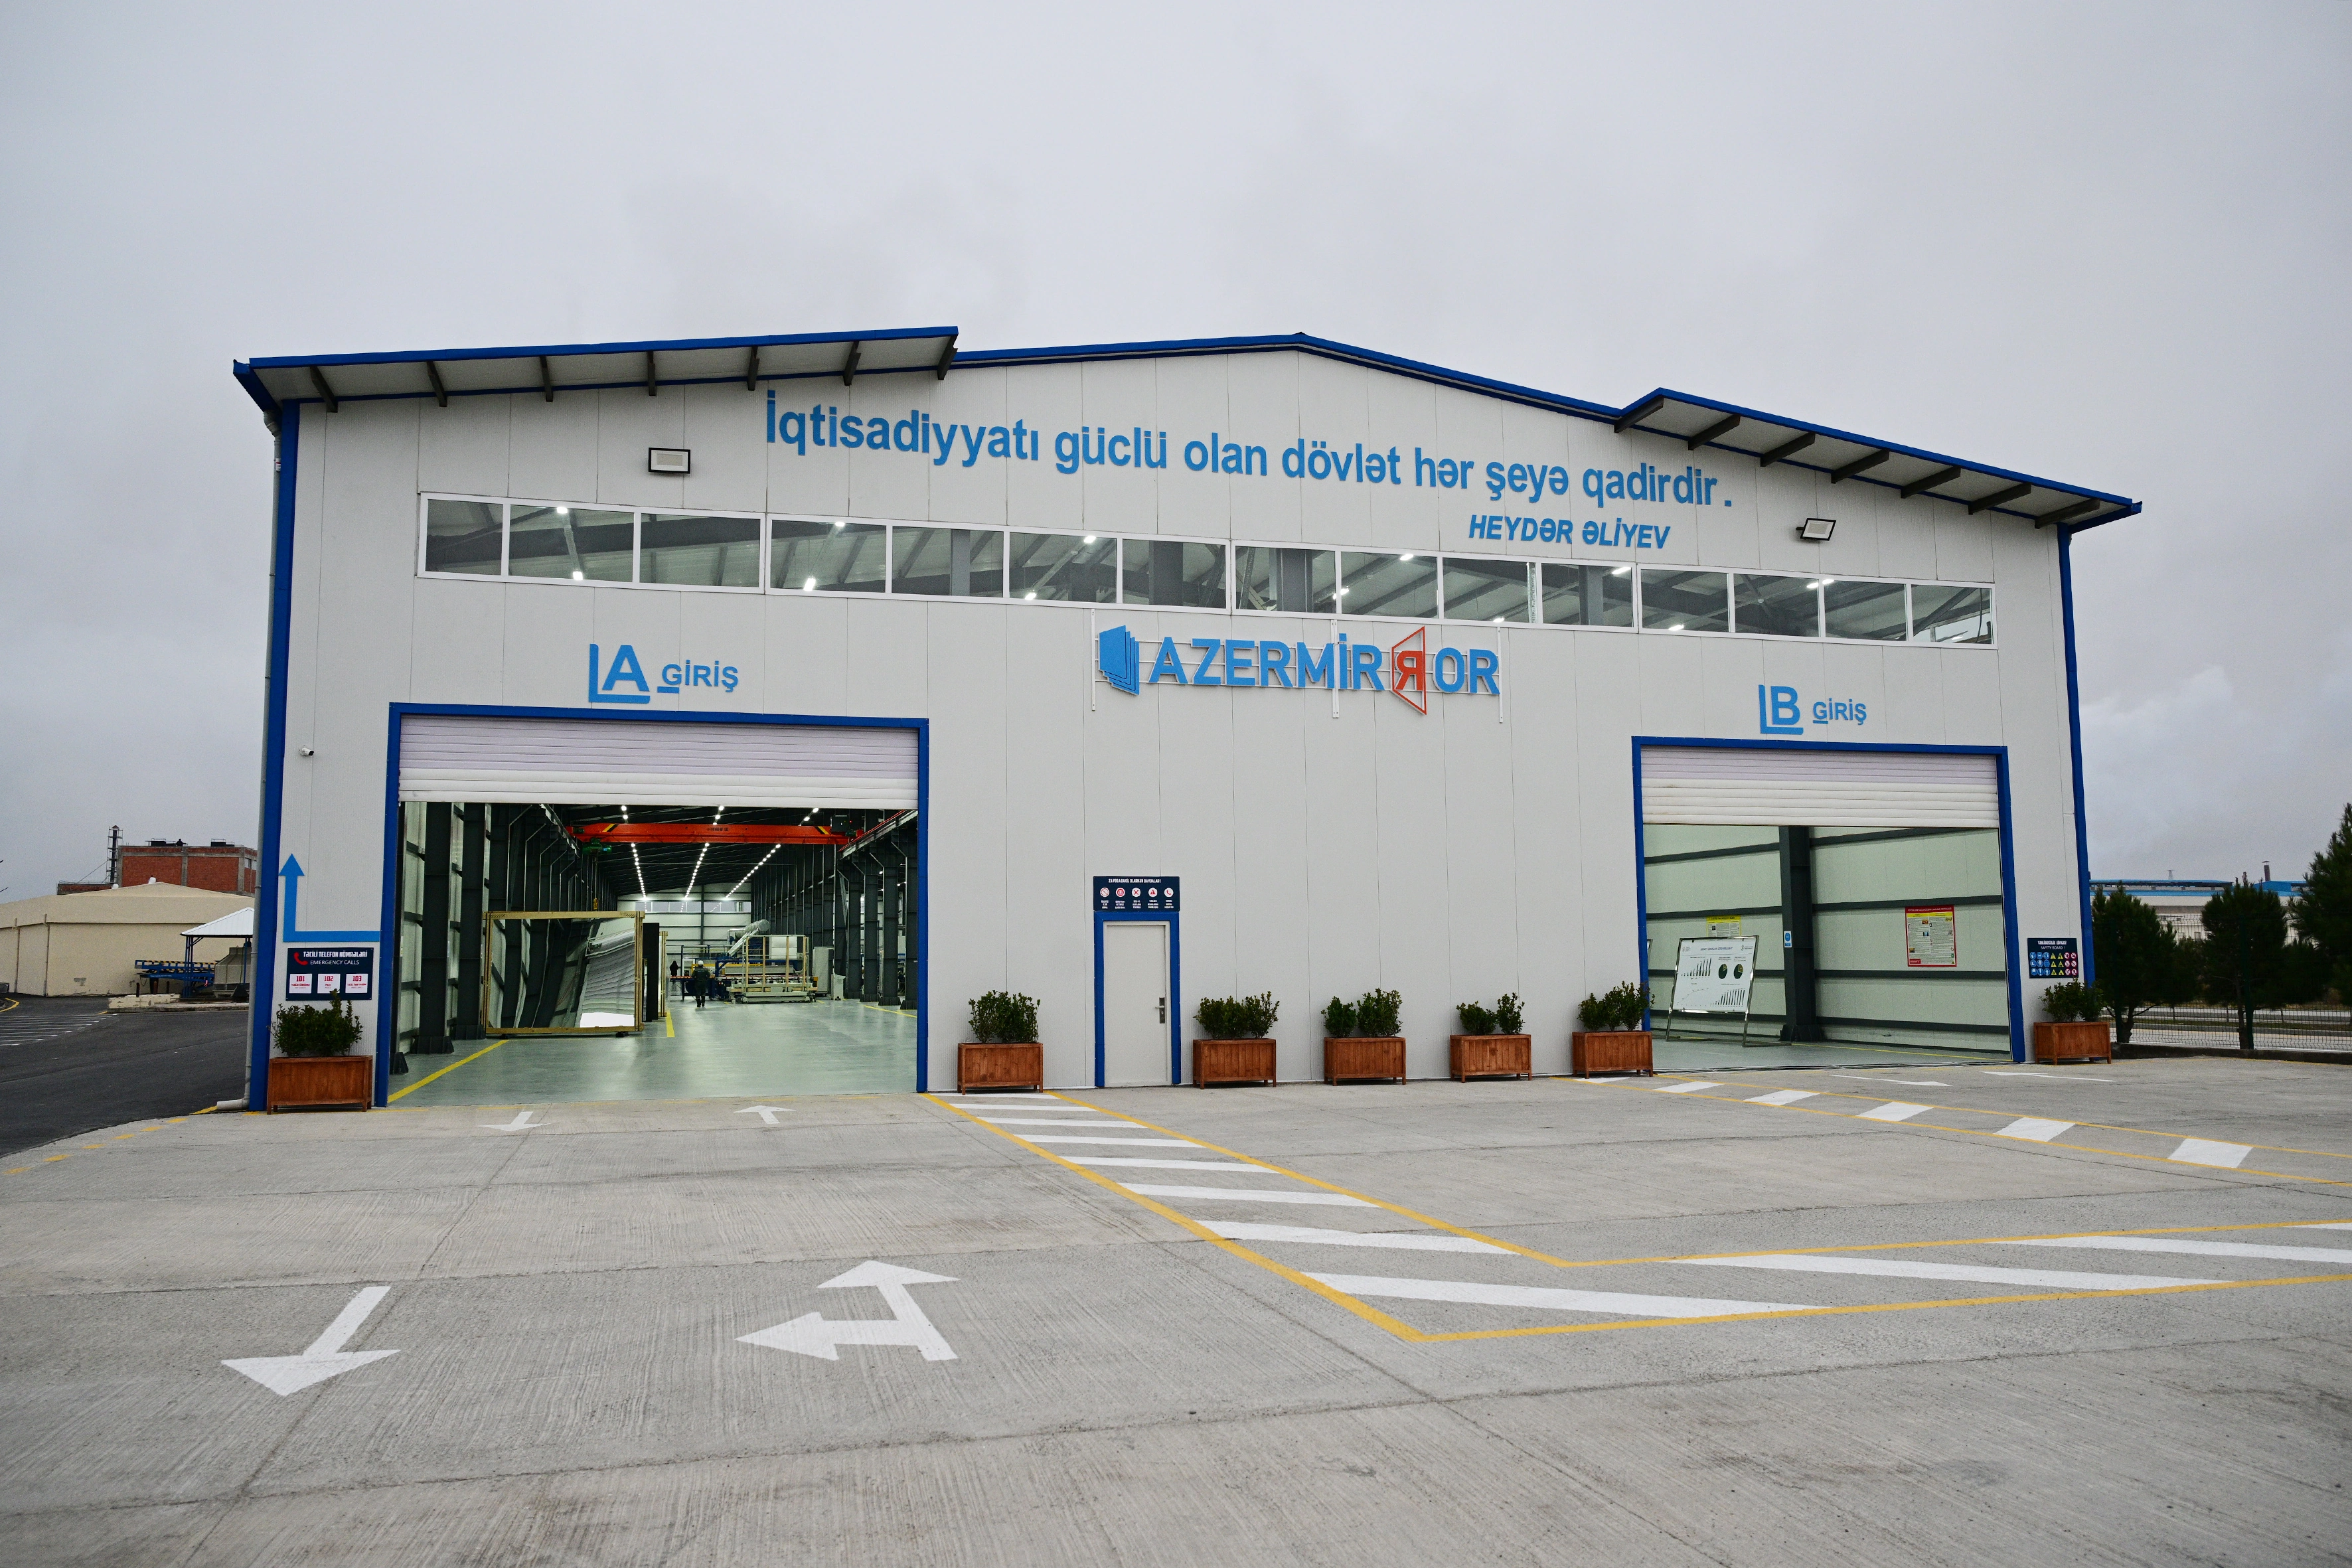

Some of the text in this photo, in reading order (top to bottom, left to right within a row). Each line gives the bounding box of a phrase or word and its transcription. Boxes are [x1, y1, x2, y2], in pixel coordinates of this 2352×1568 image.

[766, 390, 1039, 467] İqtisadiyyatı
[1055, 426, 1167, 475] güclü
[1184, 432, 1267, 476] olan
[1282, 438, 1401, 485] dövlət
[1415, 447, 1475, 489] hər
[1486, 461, 1569, 503] şeyə
[1469, 514, 1672, 549] HEYDƏR ƏLİYEV
[661, 659, 739, 692] GİRİŞ
[1812, 698, 1867, 726] GİRİŞ
